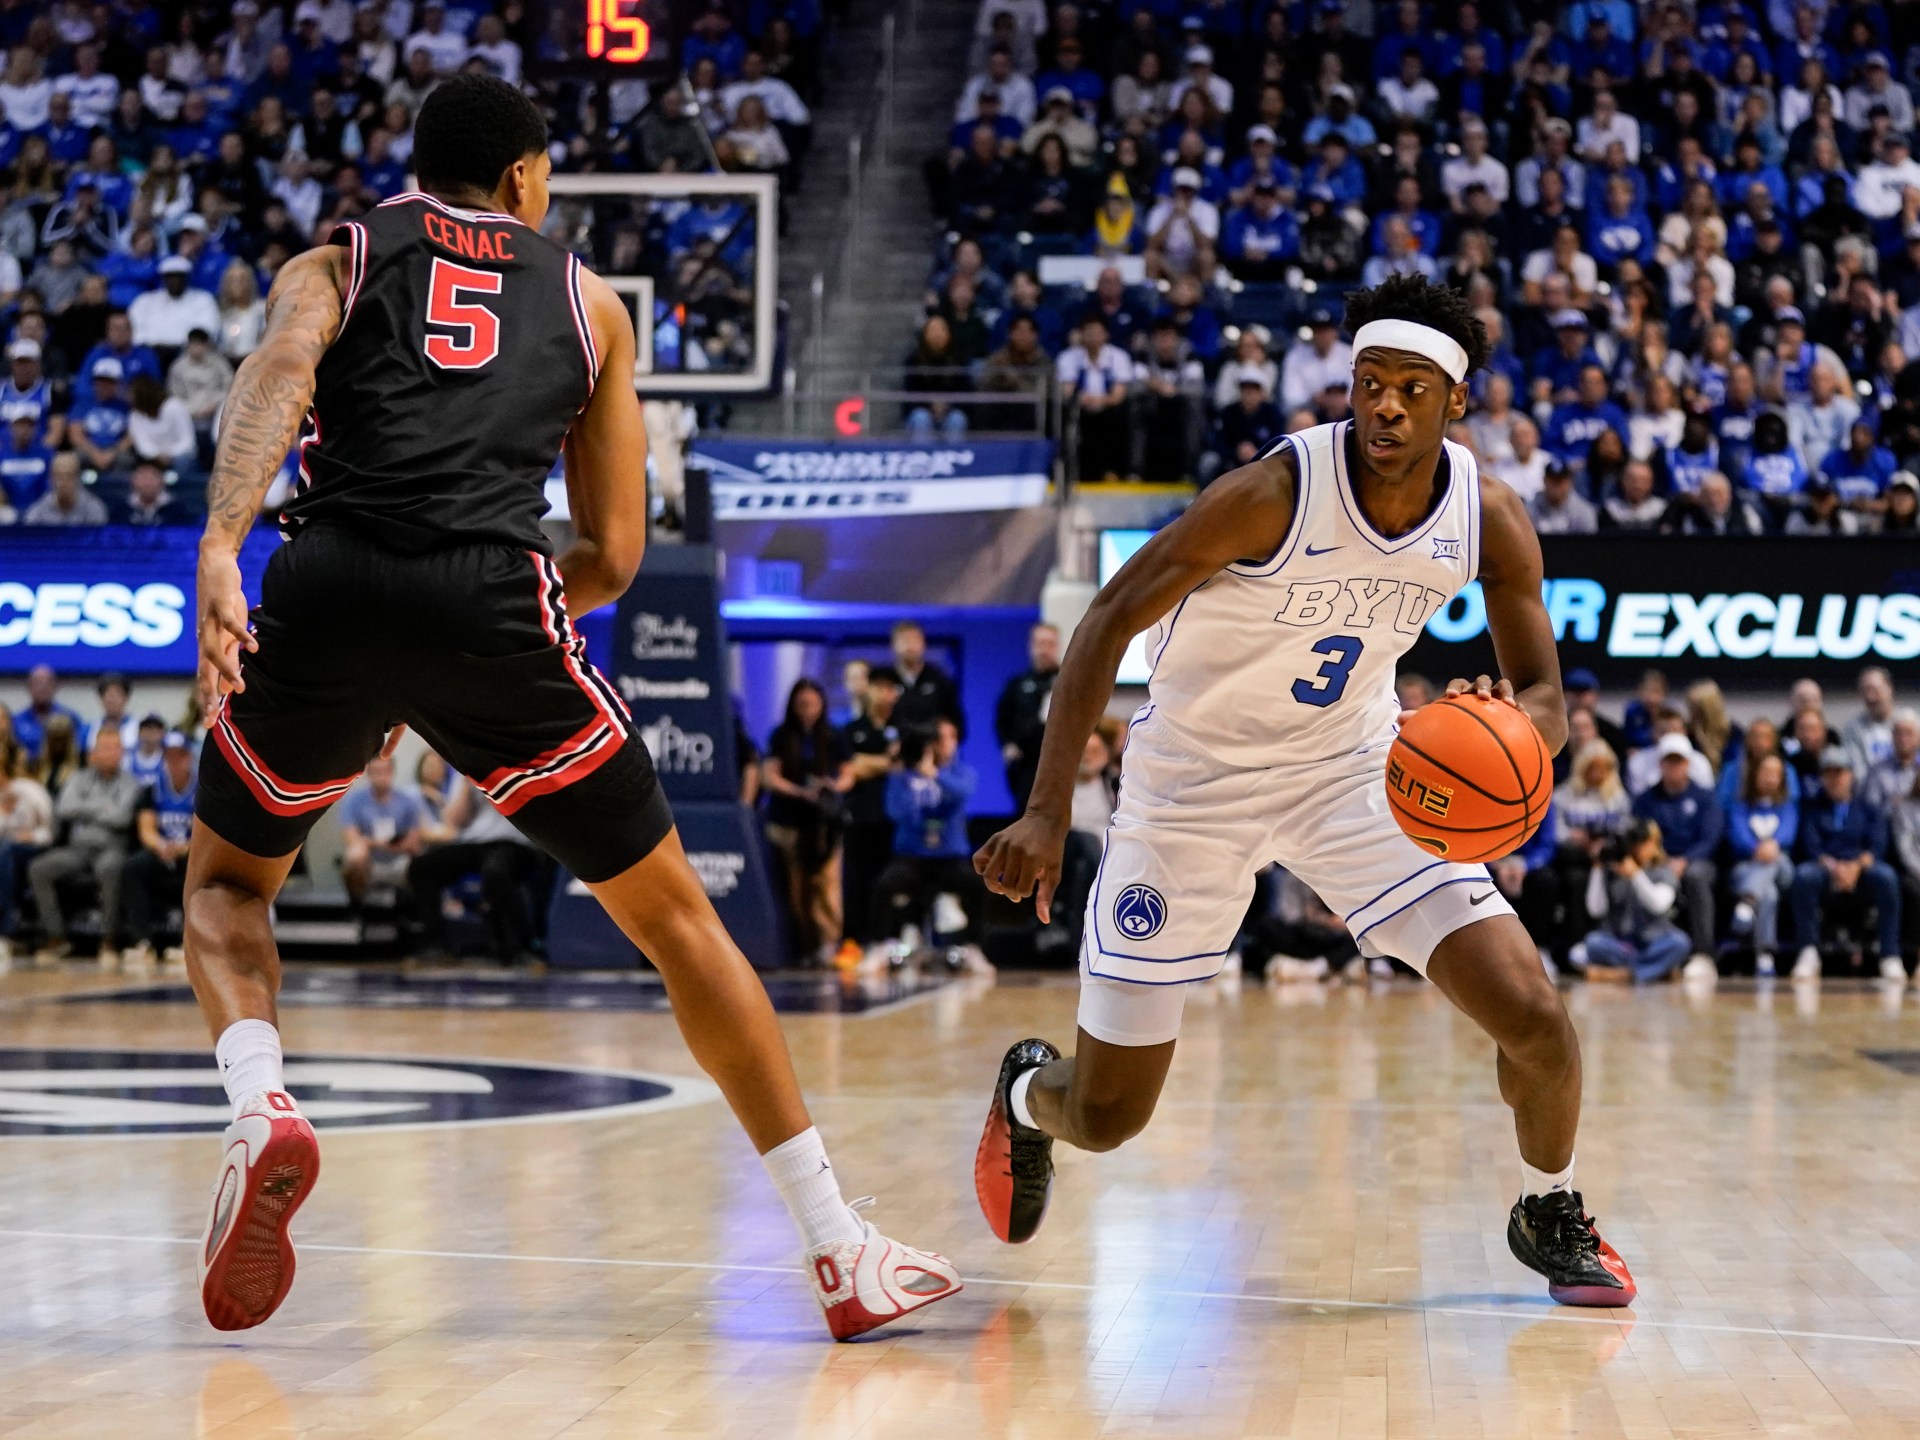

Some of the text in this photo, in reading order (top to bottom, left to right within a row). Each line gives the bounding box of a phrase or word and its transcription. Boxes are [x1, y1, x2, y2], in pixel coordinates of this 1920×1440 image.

[587, 0, 650, 62] 15
[424, 212, 514, 260] CENAC
[424, 256, 503, 369] 5
[1274, 578, 1446, 635] BYU
[1290, 634, 1364, 708] 3
[1387, 757, 1451, 818] ELITE
